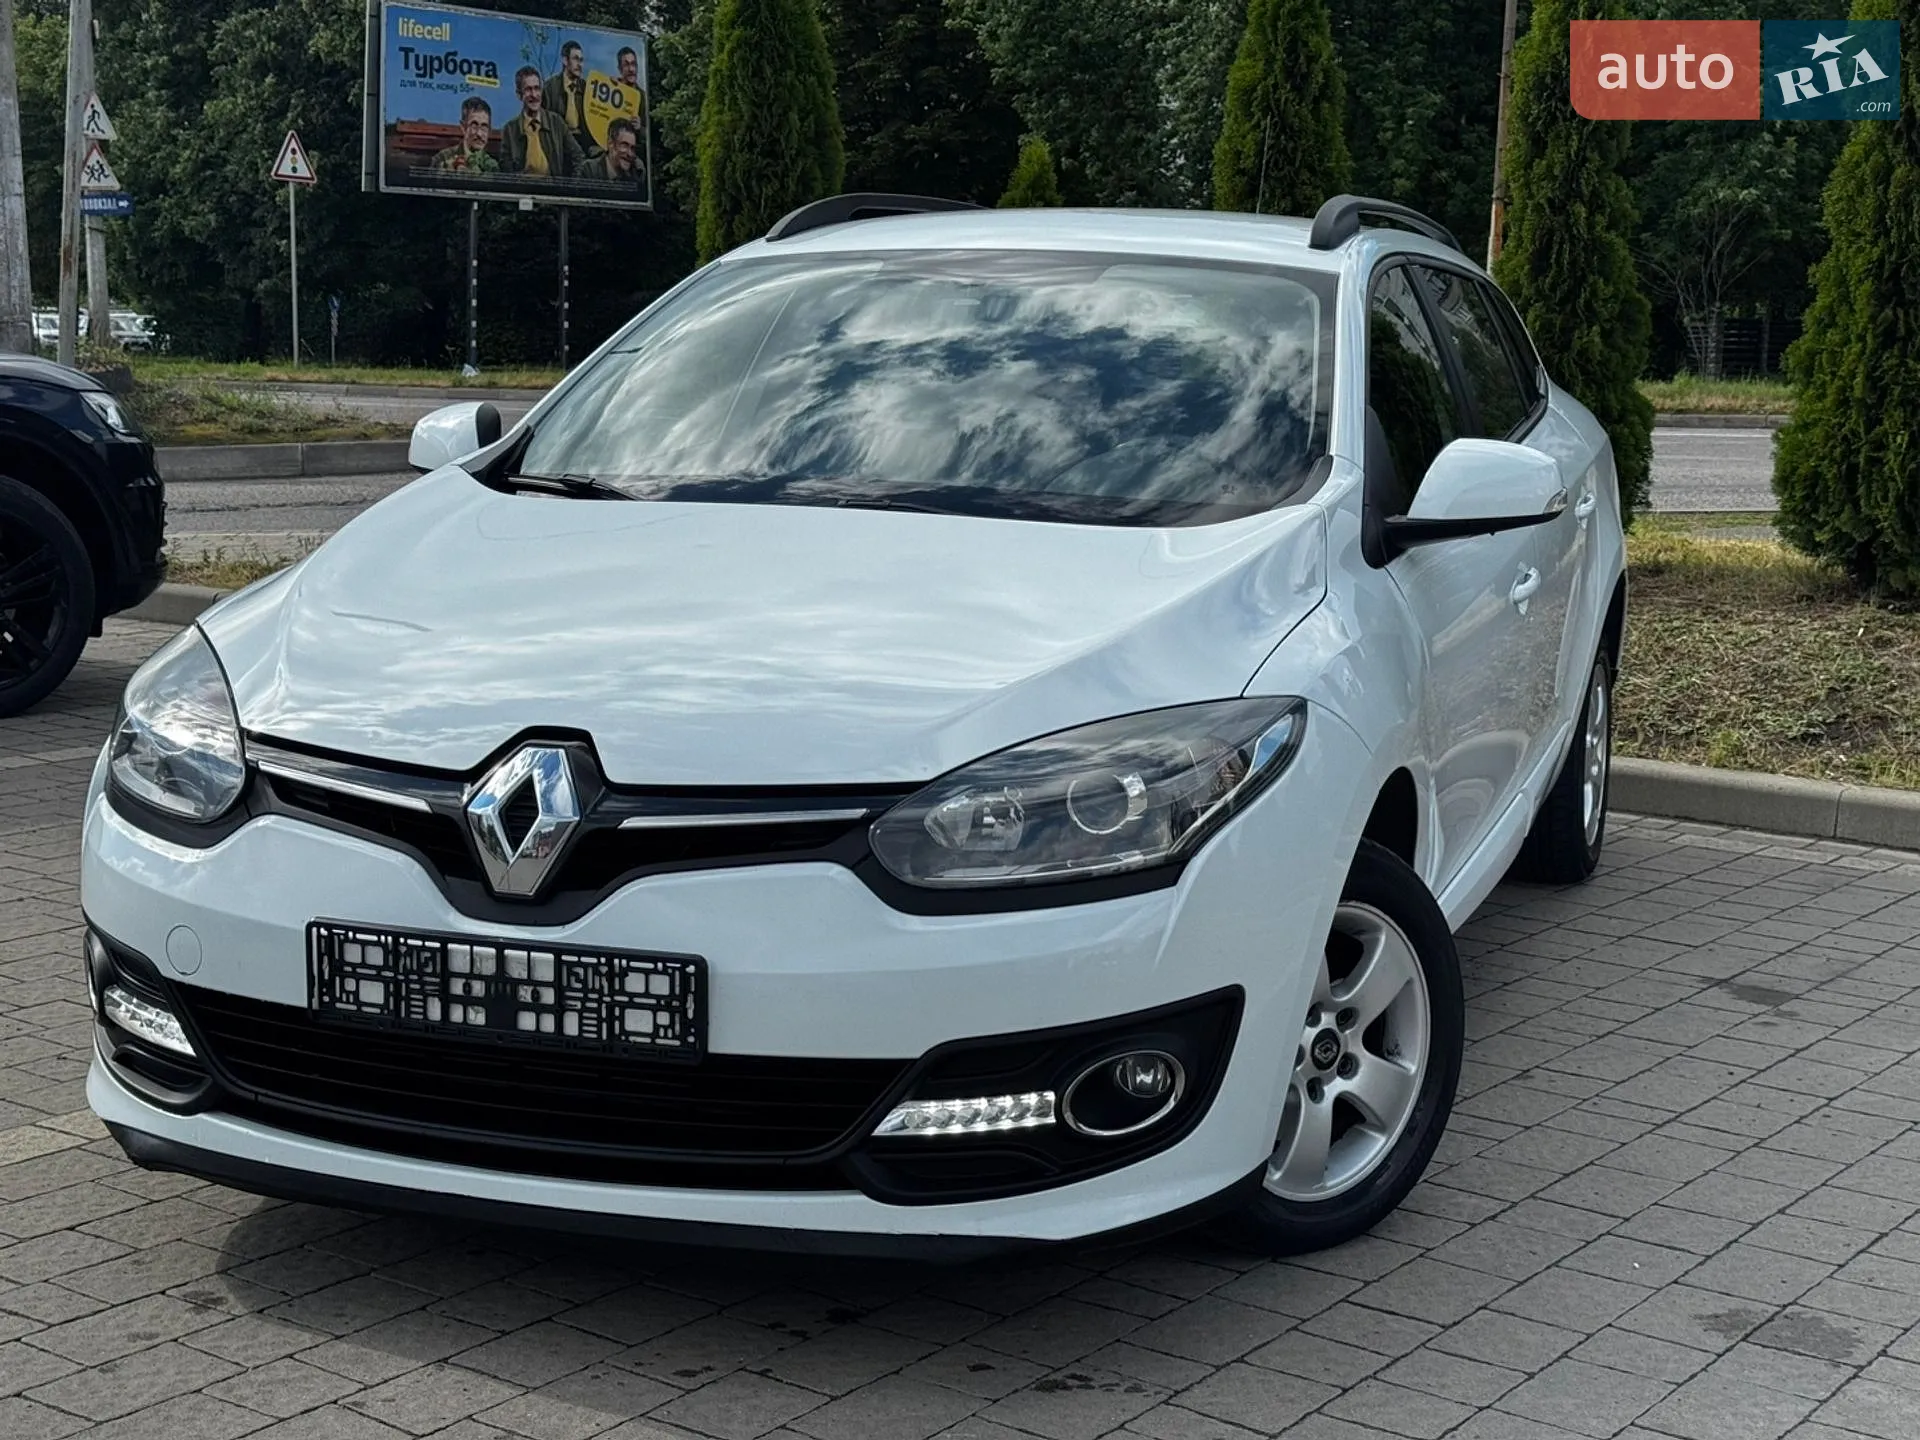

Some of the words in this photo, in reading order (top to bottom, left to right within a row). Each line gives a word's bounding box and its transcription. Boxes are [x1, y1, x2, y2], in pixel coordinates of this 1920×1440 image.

[399, 17, 450, 41] lifecell
[398, 46, 498, 79] Турбота
[590, 79, 624, 109] 190
